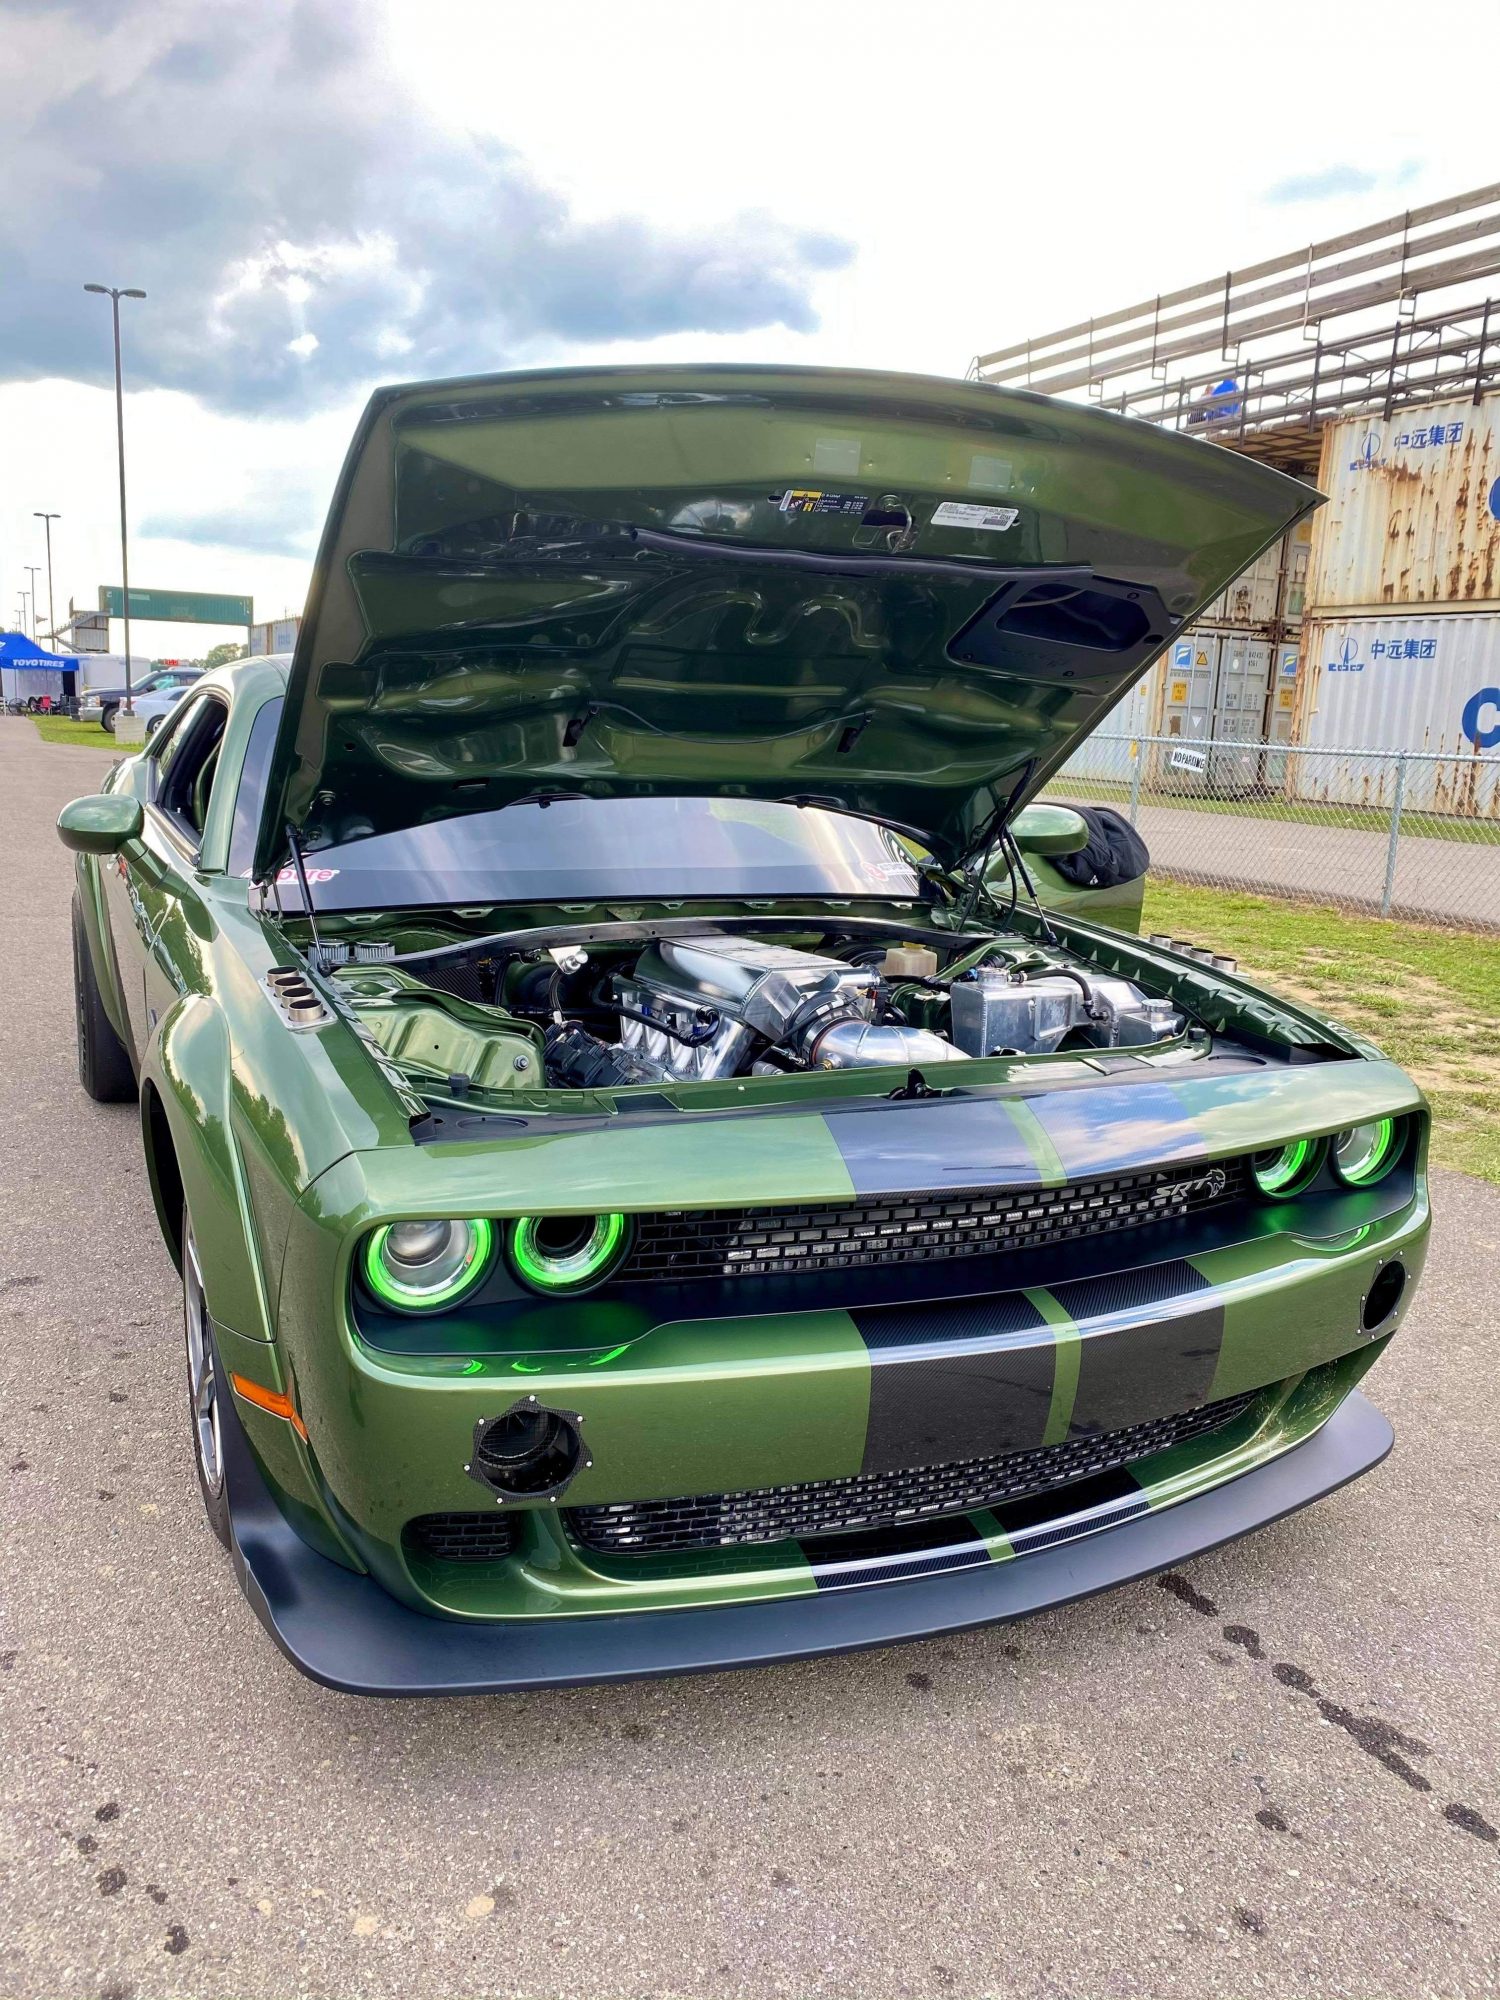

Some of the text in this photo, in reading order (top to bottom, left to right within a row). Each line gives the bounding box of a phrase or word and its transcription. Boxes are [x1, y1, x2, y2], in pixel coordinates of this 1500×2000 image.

[1371, 638, 1437, 660] 中远集团
[39, 659, 65, 668] TIRES
[1151, 1177, 1212, 1200] SRT
